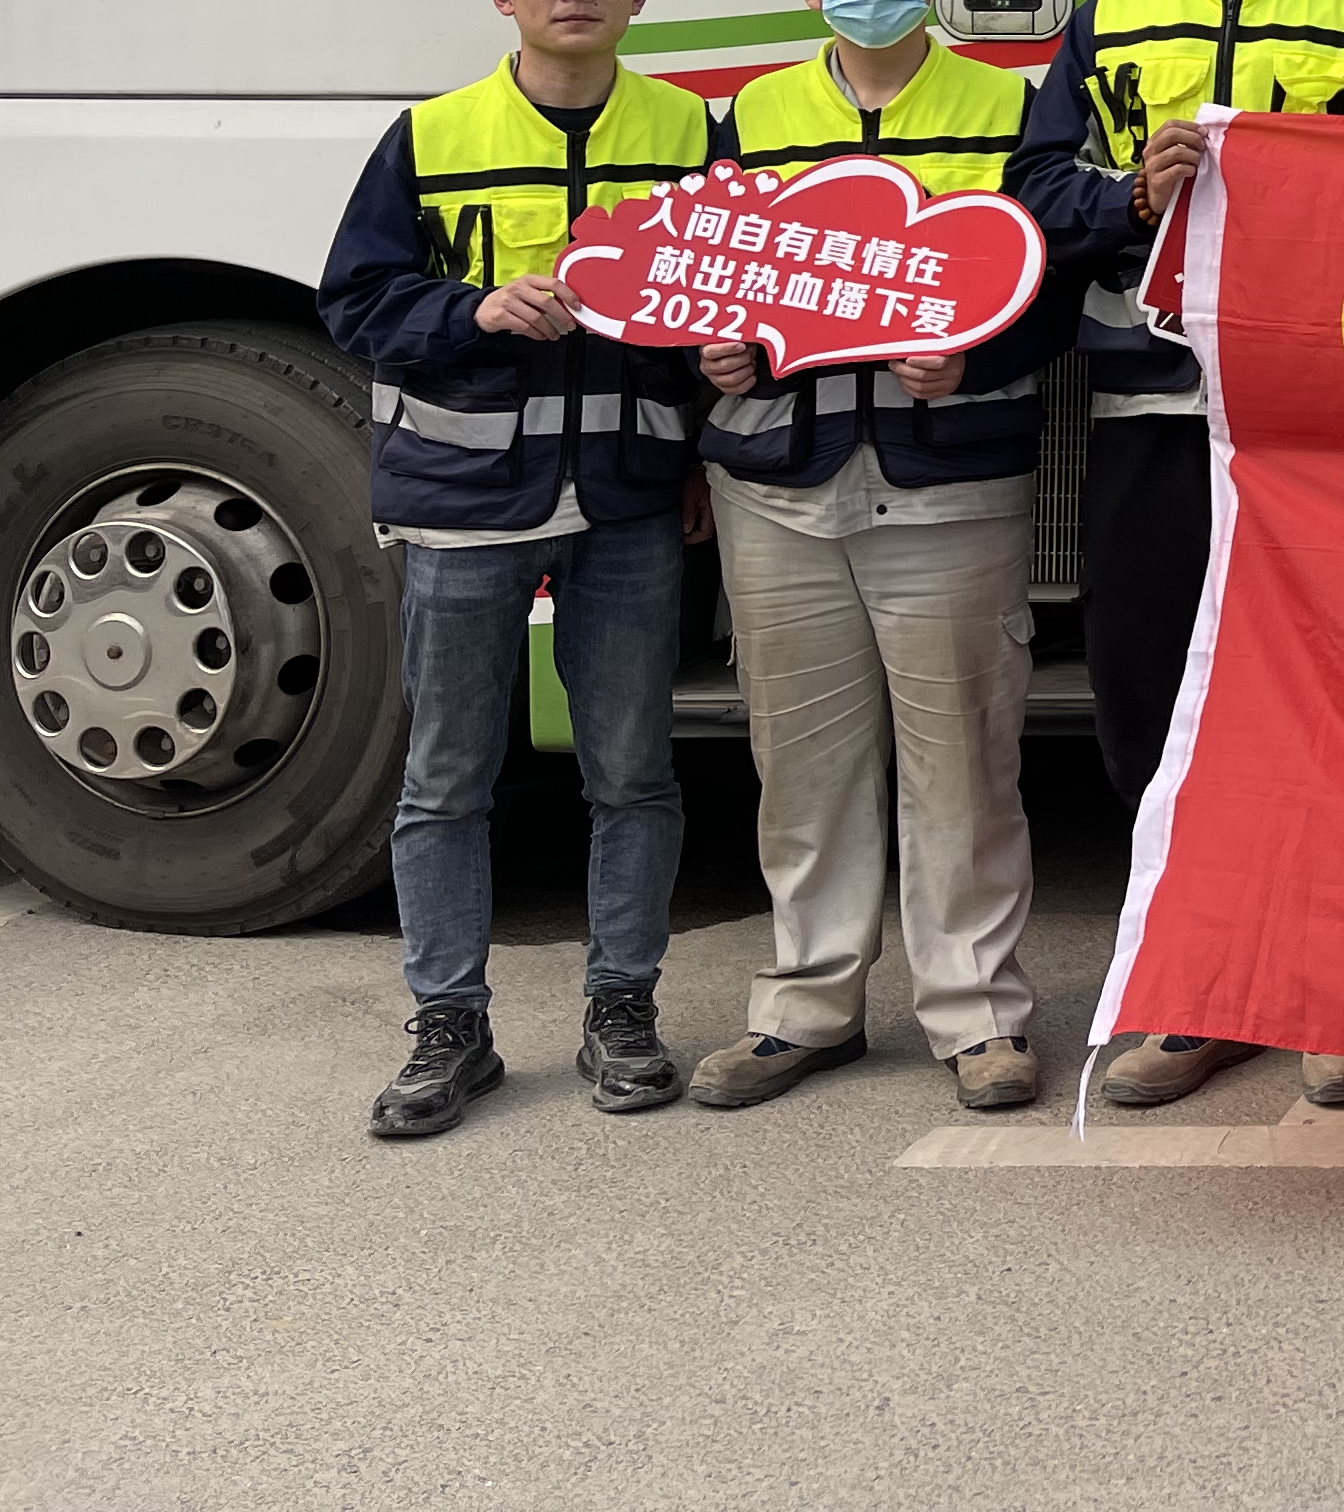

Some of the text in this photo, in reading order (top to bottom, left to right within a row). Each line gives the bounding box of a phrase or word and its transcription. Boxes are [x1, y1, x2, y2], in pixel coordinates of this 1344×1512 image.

[638, 196, 950, 288] 人间自有真情在
[630, 288, 749, 341] 2022
[646, 245, 958, 339] 献出热血播下爱
